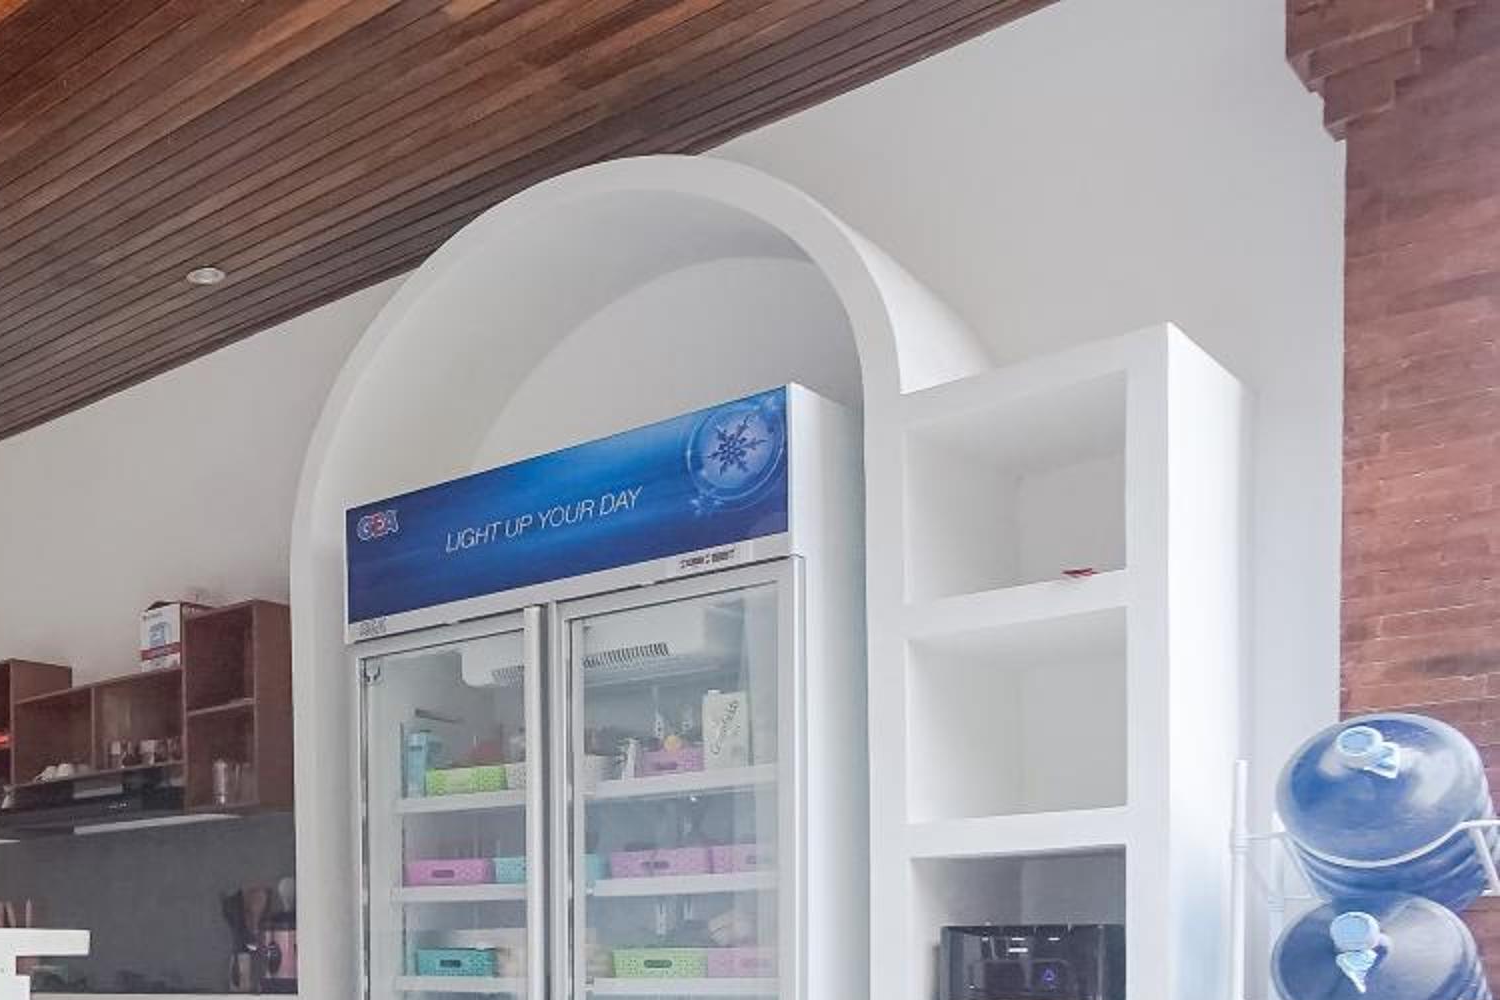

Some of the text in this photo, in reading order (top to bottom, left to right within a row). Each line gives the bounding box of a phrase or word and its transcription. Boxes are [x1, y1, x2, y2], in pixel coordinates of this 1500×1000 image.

[446, 486, 644, 553] LIGHT UP YOUR DAY
